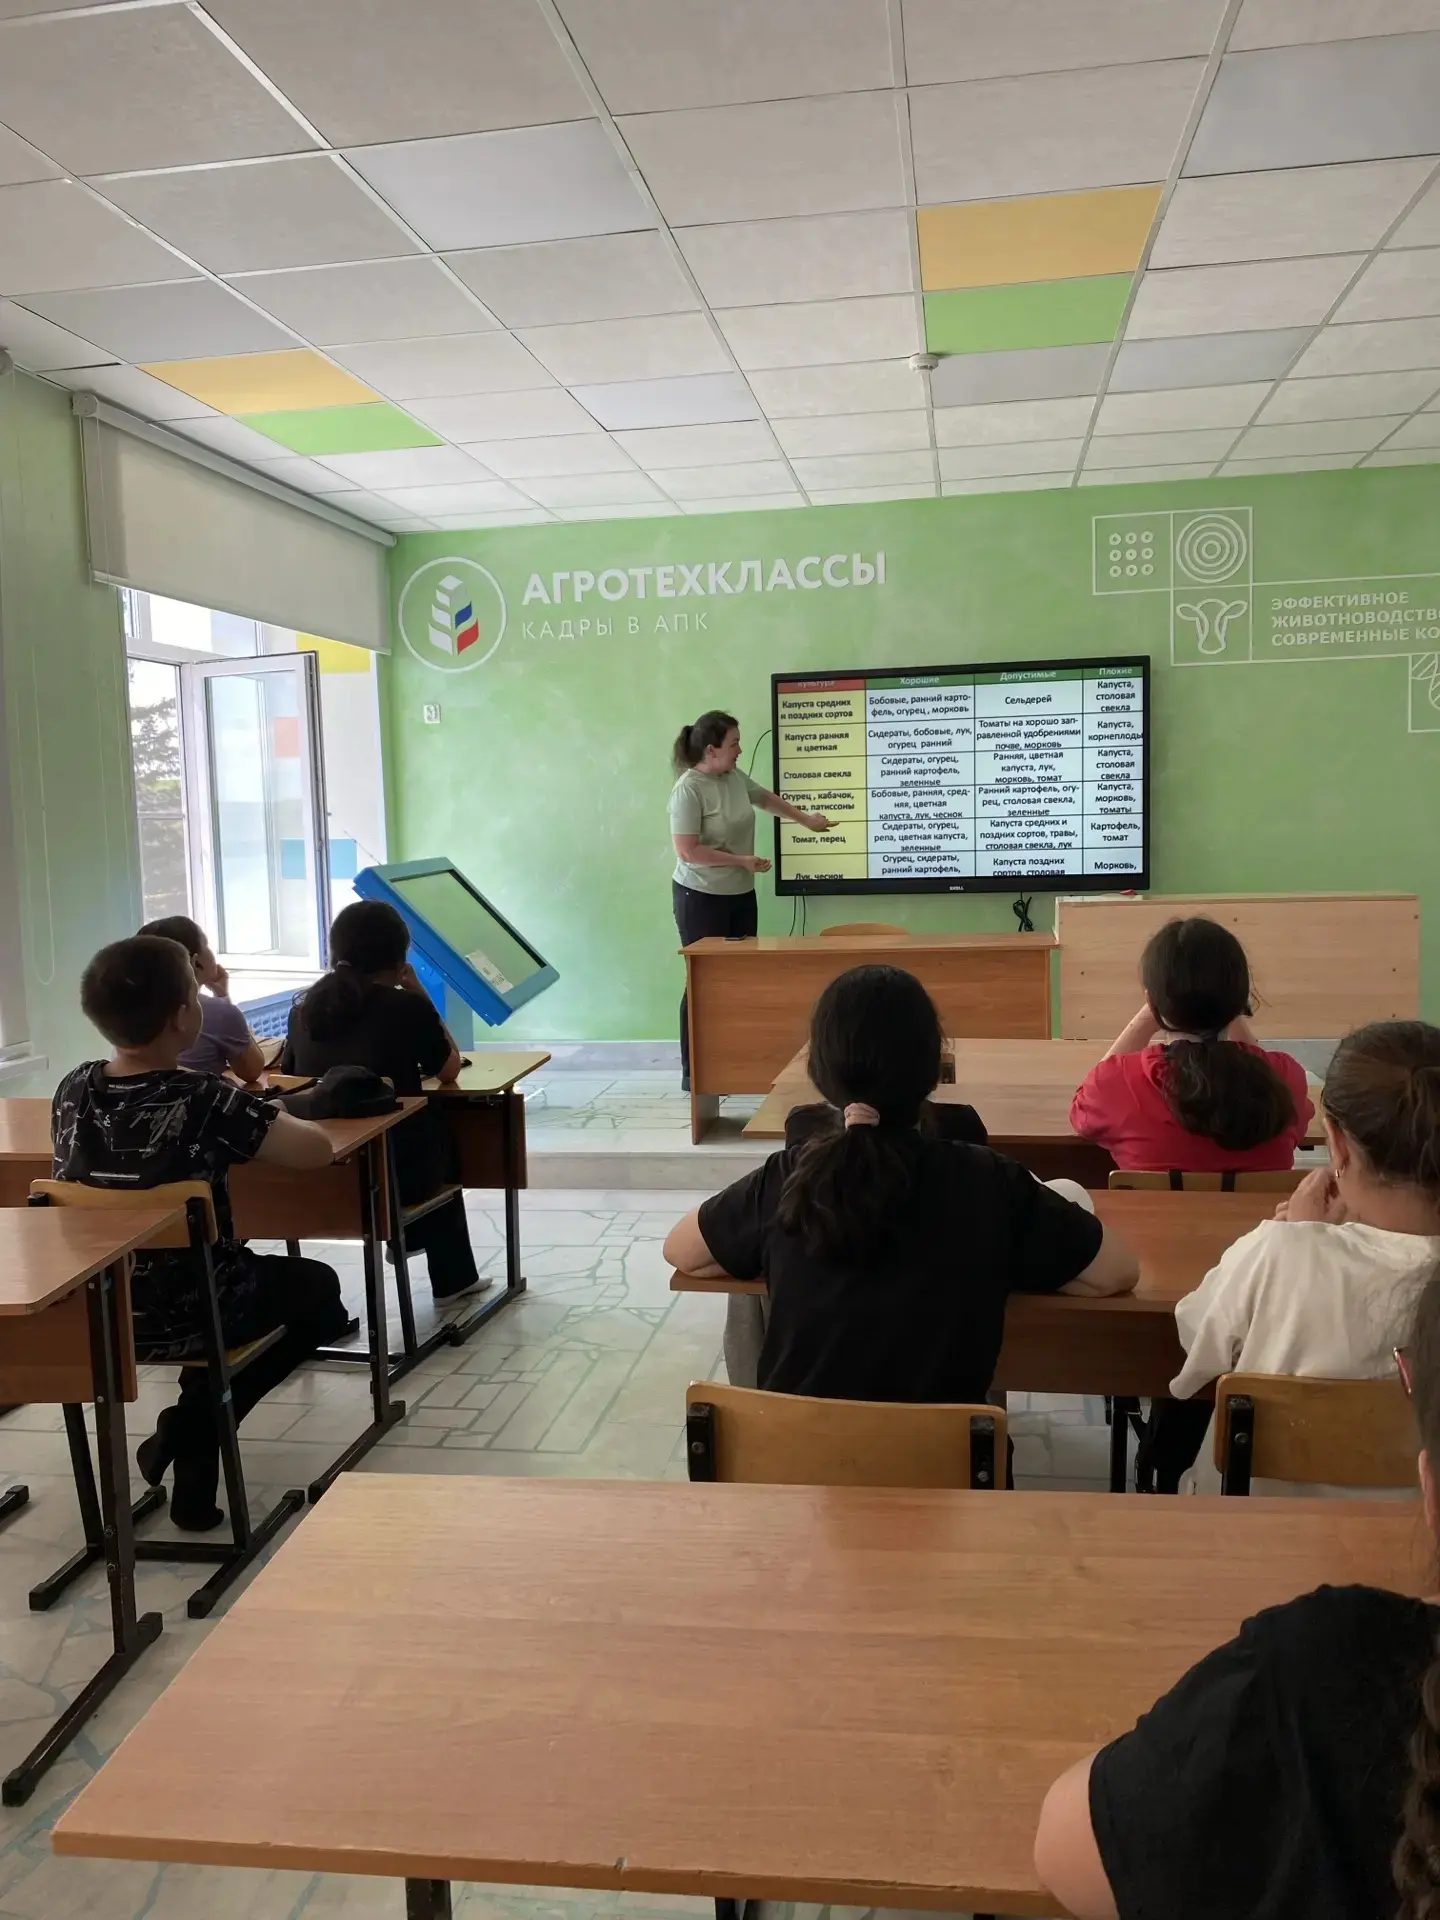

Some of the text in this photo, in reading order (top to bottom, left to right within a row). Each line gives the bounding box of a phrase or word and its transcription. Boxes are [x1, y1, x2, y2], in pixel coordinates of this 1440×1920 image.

[522, 551, 886, 605] АГРОТЕХКЛАССЫ
[1272, 592, 1408, 610] ЭФФЕКТИВНОЕ
[1272, 608, 1440, 628] ЖИВОТНОВОДСТВ
[523, 612, 709, 640] КАДРЫ В АПК
[1272, 628, 1409, 646] СОВРЕМЕННЫЕ
[900, 676, 939, 685] Хорошие
[1000, 671, 1056, 681] Допустимые
[1098, 681, 1134, 689] Капуста,
[870, 694, 971, 705] Бобовые, ранний карто-
[1005, 695, 1052, 704] Сельдерей
[1096, 692, 1135, 700] столовая
[817, 700, 851, 708] средних
[871, 709, 894, 717] фель,
[932, 706, 969, 714] морковь
[979, 719, 1011, 727] Томаты
[868, 728, 971, 738] Сидераты, бобовые, лук,
[977, 729, 1080, 740] равленной удобрениями
[804, 744, 837, 752] цветная
[888, 739, 952, 749] огурец ранний
[1025, 742, 1061, 750] морковь
[882, 756, 958, 765] Сидераты, огурец,
[881, 767, 960, 777] ранний картофель,
[1001, 764, 1036, 772] капуста,
[784, 771, 821, 779] Столовая
[978, 786, 1010, 794] Ранний
[1012, 785, 1060, 794] картофель,
[1098, 783, 1133, 791] Капуста,
[782, 793, 811, 801] Огурец
[818, 792, 854, 800] кабачок,
[872, 788, 970, 798] Бобовые, ранняя, сред-
[811, 803, 854, 811] патиссоны
[894, 800, 911, 808] няя,
[883, 822, 959, 831] Сидераты, огурец,
[1025, 819, 1060, 827] средних
[1091, 823, 1140, 831] Картофель,
[875, 834, 896, 842] репа,
[934, 832, 968, 840] капуста,
[980, 830, 1078, 839] поздних сортов, травы,
[883, 854, 959, 863] Огурец, сидераты,
[993, 858, 1026, 866] Капуста
[882, 865, 960, 874] ранний картофель,
[1095, 862, 1137, 870] Морковь,
